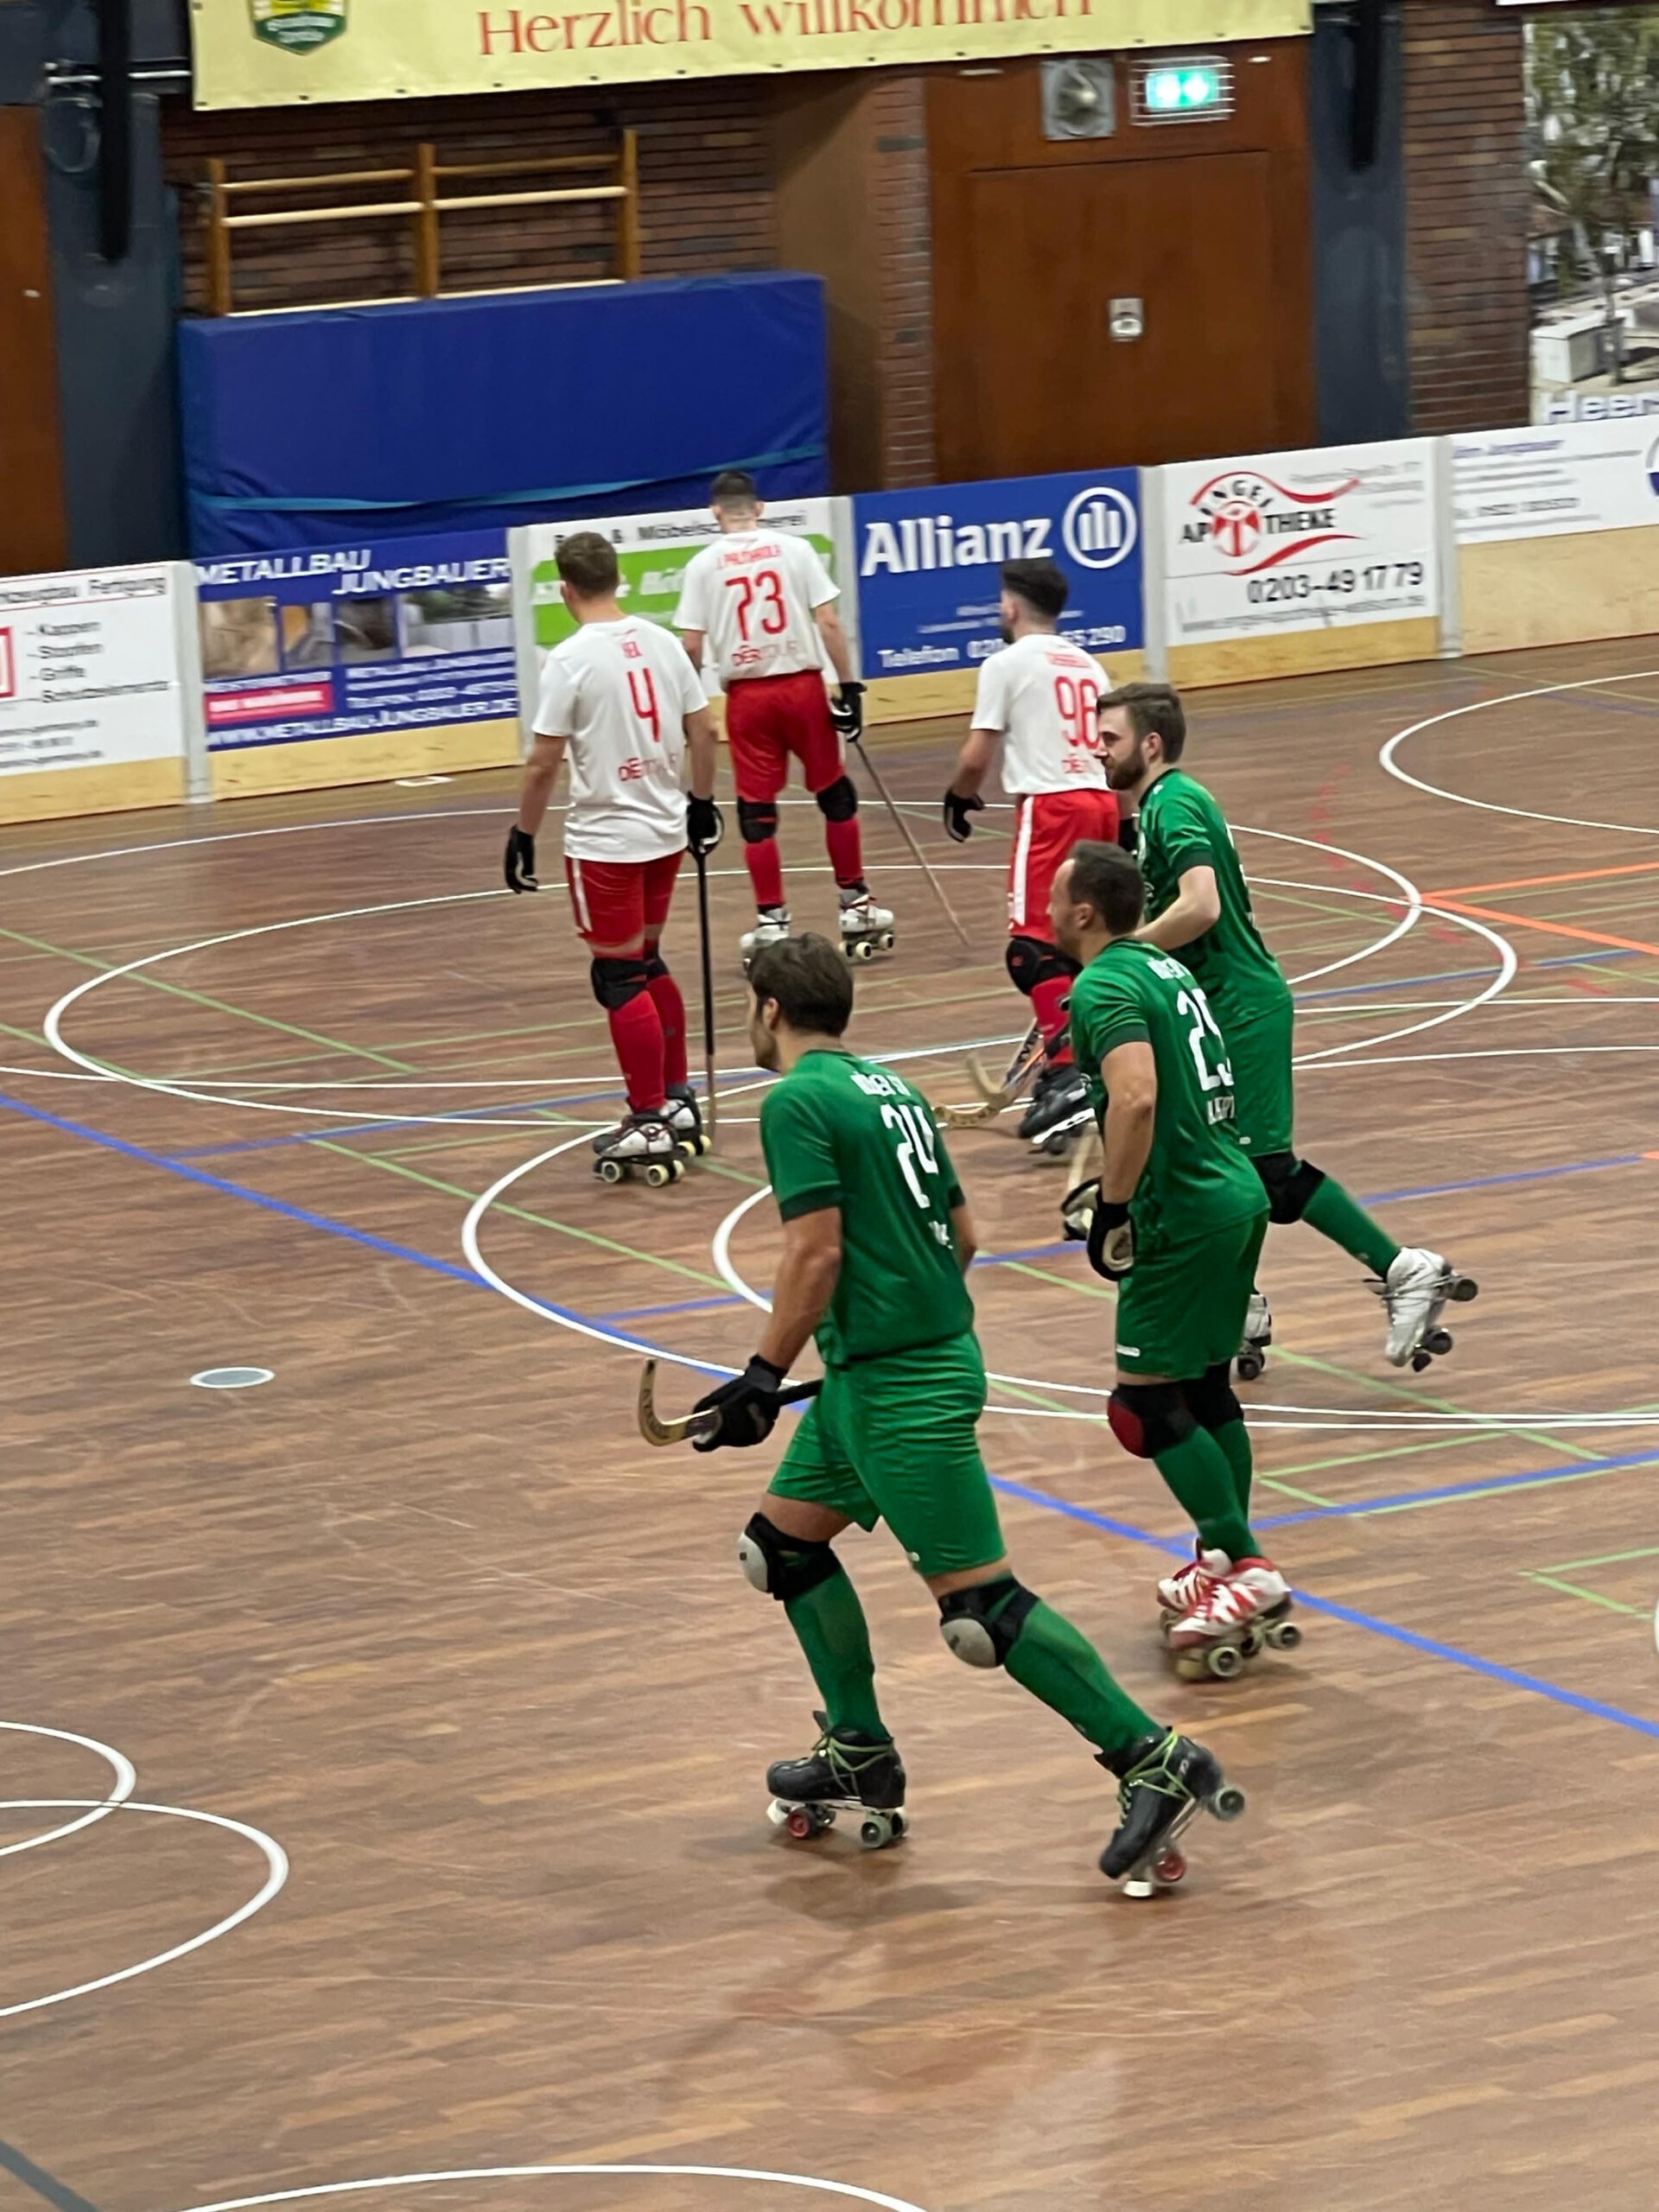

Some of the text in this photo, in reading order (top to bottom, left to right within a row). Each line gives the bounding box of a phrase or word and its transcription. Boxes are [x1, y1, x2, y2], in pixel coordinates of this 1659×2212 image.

[477, 0, 711, 54] Herzlich
[332, 557, 509, 594] JUNGBAUER
[861, 515, 1053, 576] Allianz
[724, 570, 788, 642] 73
[626, 668, 660, 743] 4
[880, 1103, 939, 1209] 24
